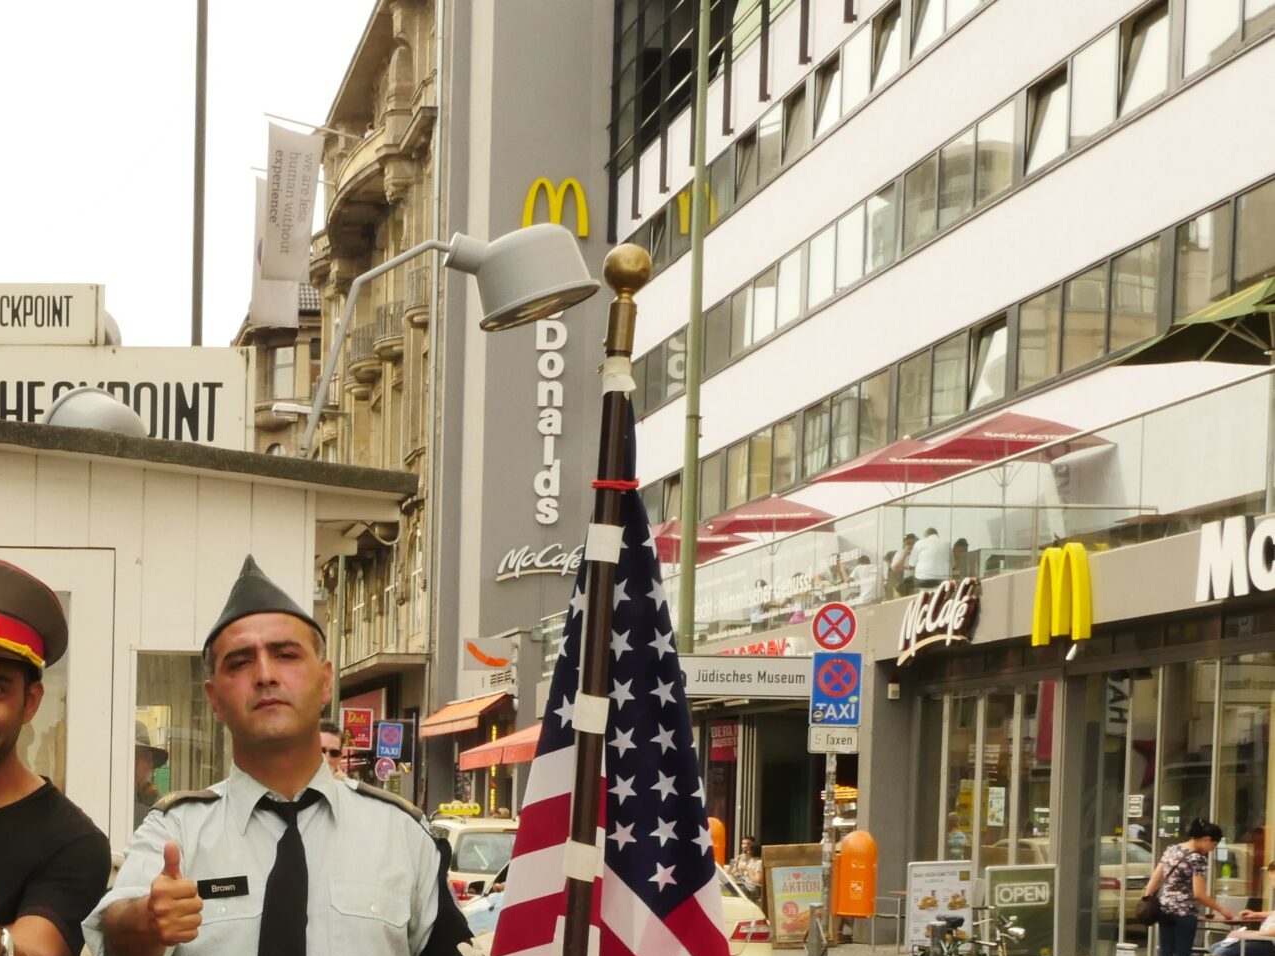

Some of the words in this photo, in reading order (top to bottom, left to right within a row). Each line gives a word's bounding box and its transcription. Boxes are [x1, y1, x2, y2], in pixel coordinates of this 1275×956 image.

[305, 153, 314, 172] we
[286, 152, 302, 199] human
[301, 175, 311, 197] are
[297, 199, 310, 223] less
[279, 201, 296, 254] without
[532, 310, 568, 525] Donalds
[695, 669, 753, 684] Jüdisches
[757, 670, 806, 684] Museum
[815, 702, 856, 720] TAXI
[380, 746, 399, 755] TAXI
[782, 880, 820, 893] AKTION
[999, 886, 1047, 902] OPEN
